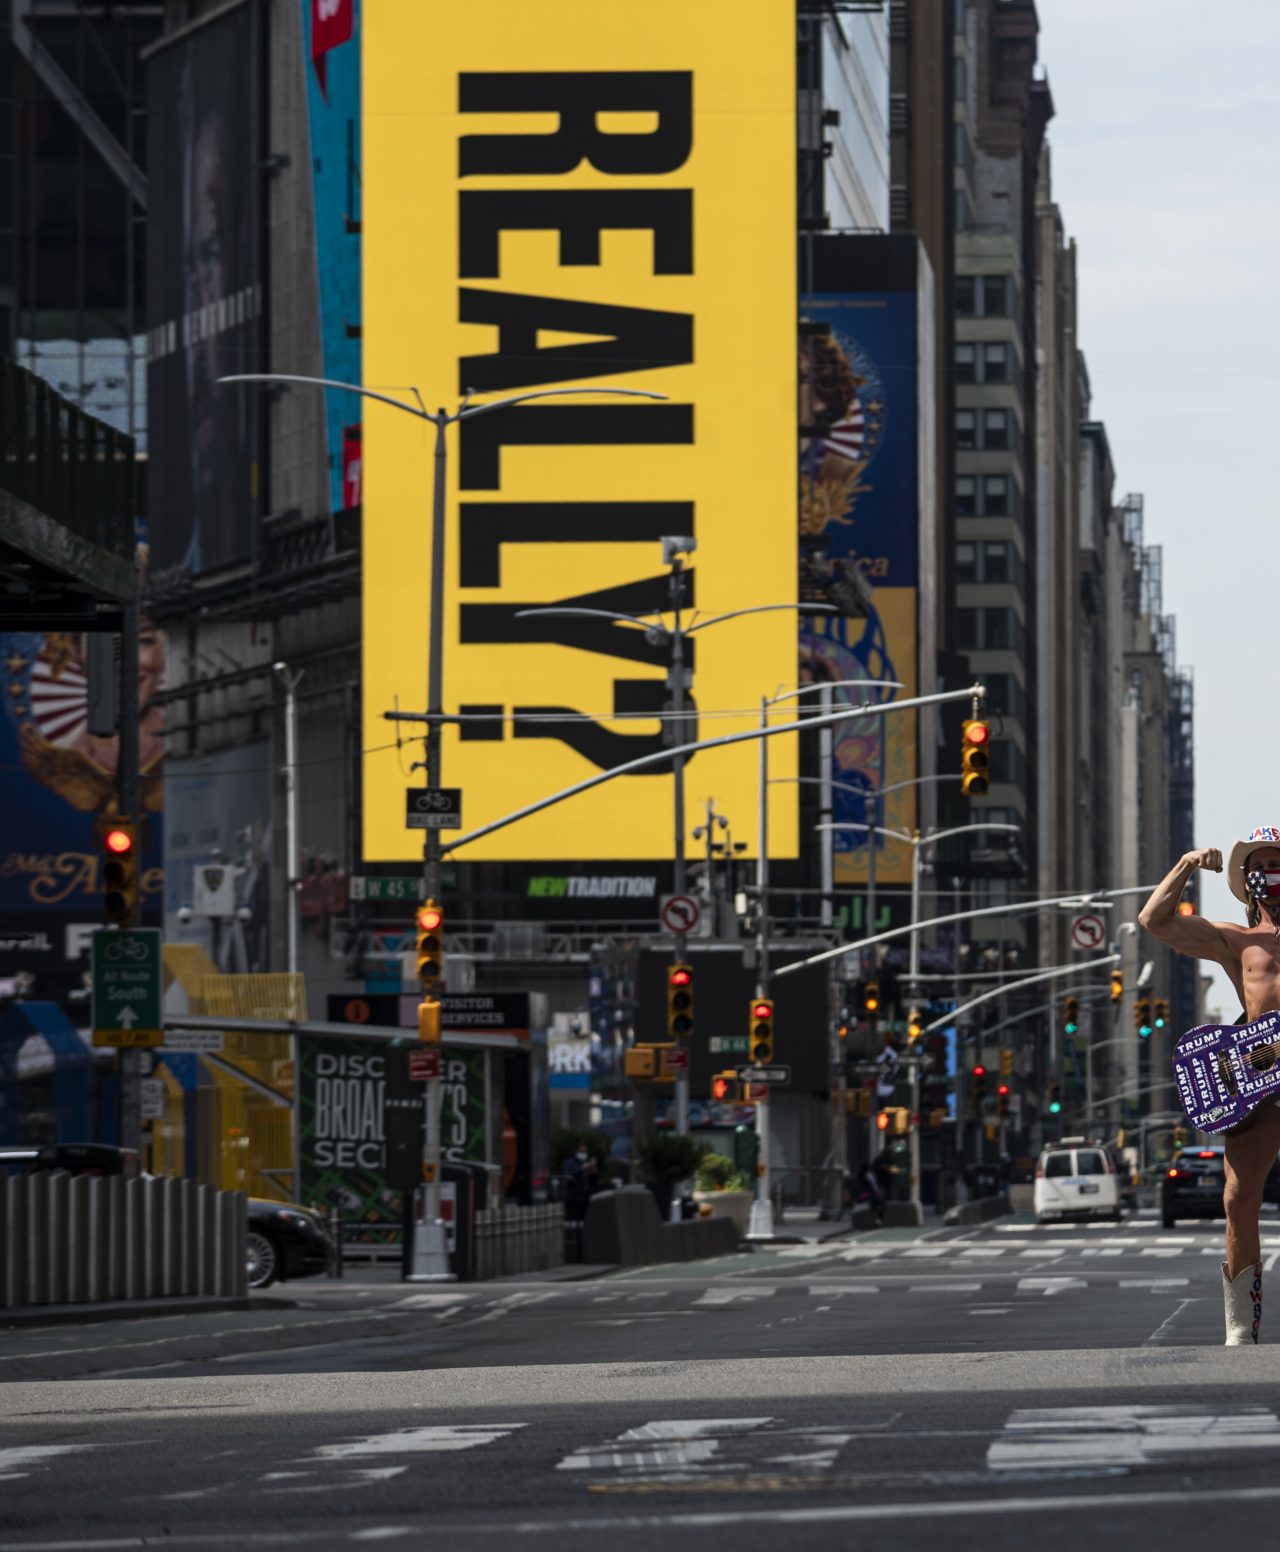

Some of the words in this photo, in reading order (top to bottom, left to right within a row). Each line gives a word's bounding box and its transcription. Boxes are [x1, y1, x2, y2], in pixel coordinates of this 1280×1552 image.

[458, 70, 698, 775] REALLY?
[368, 882, 381, 897] W
[387, 881, 405, 897] 45
[106, 986, 148, 1000] South
[1177, 1030, 1222, 1053] TRUMP
[1231, 1017, 1277, 1041] TRUMP
[316, 1054, 467, 1082] DISCER
[1229, 1048, 1245, 1088] TRUM
[1176, 1064, 1194, 1115] TRUMP
[1192, 1058, 1211, 1108] TRUMP
